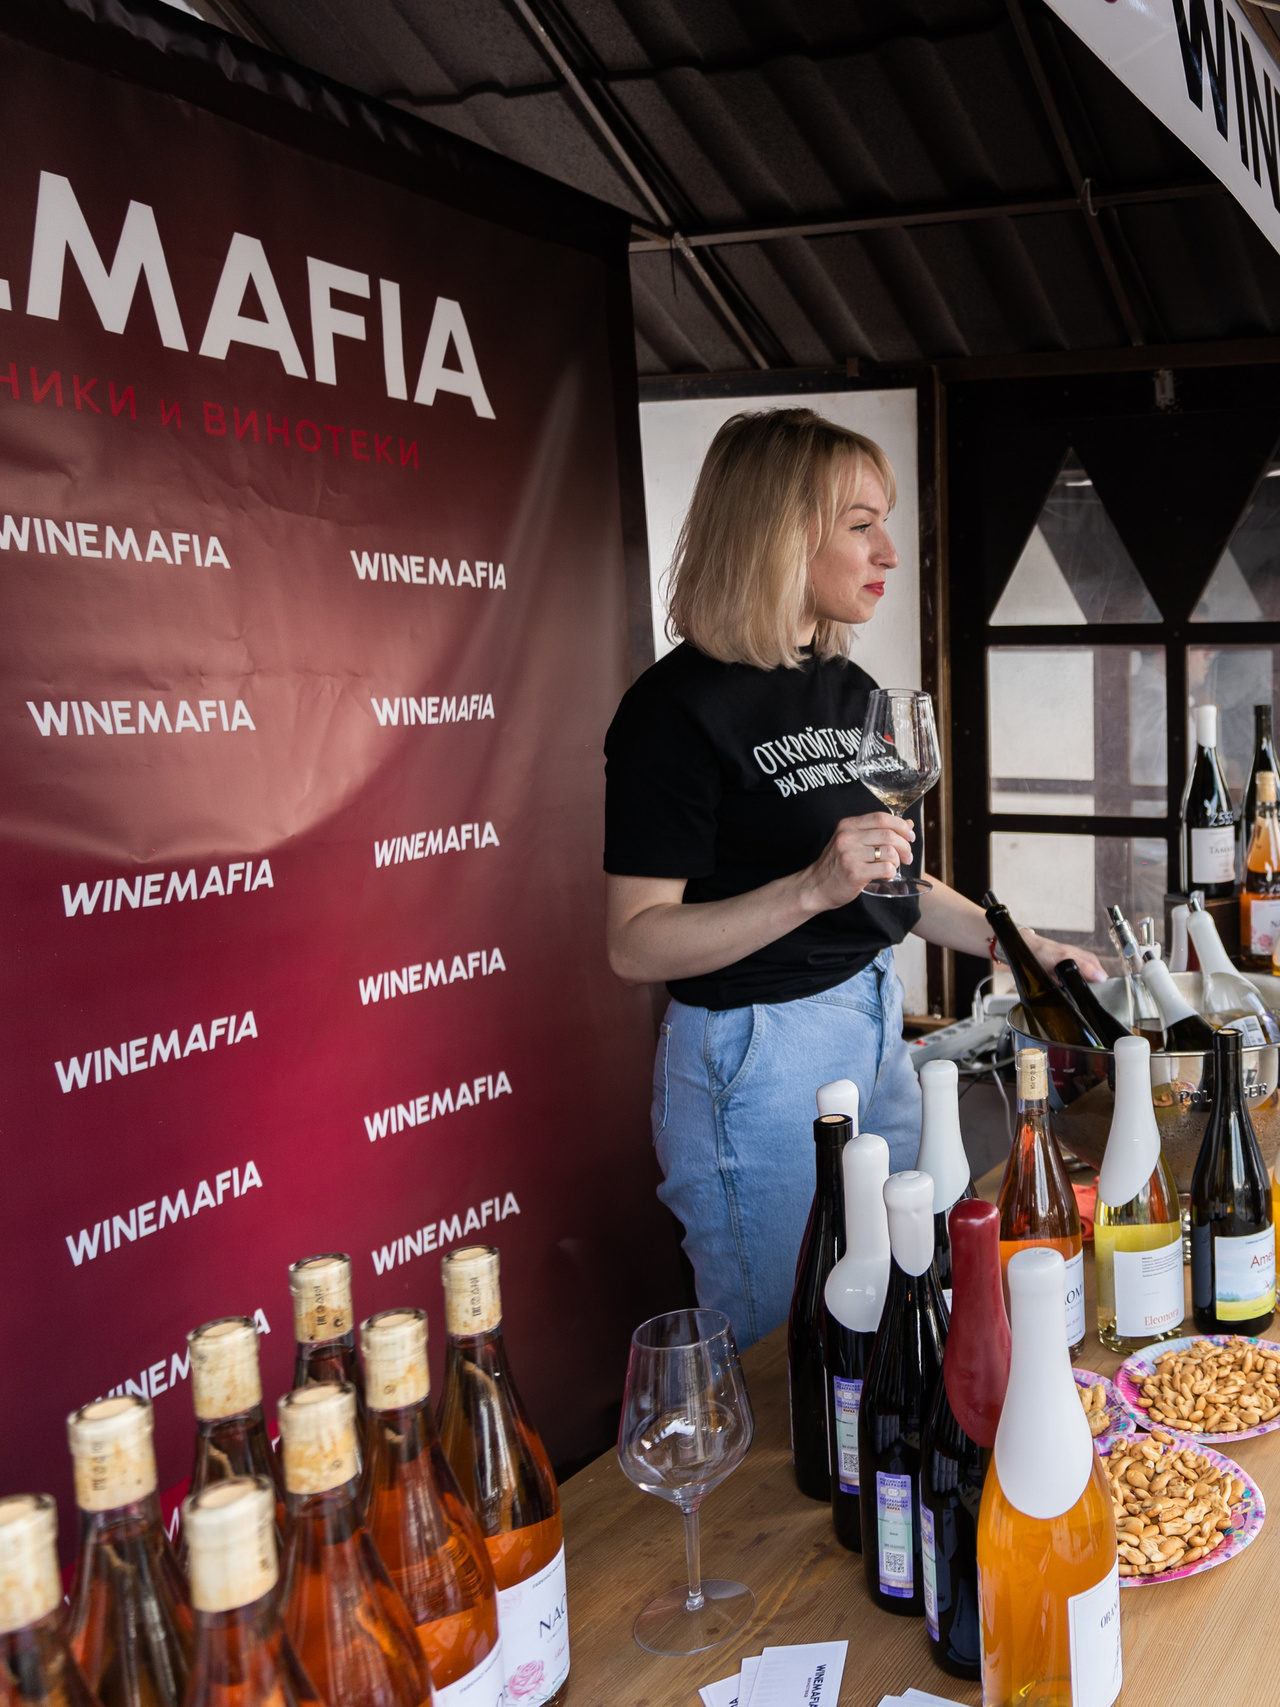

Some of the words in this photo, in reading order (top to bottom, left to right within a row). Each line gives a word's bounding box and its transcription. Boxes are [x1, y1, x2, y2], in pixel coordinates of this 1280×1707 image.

[0, 170, 496, 420] MAFIA
[204, 402, 420, 470] ВИНОТЕКИ
[0, 514, 231, 569] WINEMAFIA
[350, 551, 507, 590] WINEMAFIA
[26, 700, 257, 737] WINEMAFIA
[371, 693, 496, 727] WINEMAFIA
[753, 726, 845, 775] ОТКРОЙТЕ
[774, 763, 852, 798] ВКЛЮЧИТЕ
[374, 822, 500, 868] WINEMAFIA
[62, 859, 275, 917] WINEMAFIA
[359, 947, 506, 1005] WINEMAFIA
[55, 1010, 258, 1093] WINEMAFIA
[364, 1071, 512, 1142] WINEMAFIA
[65, 1160, 263, 1267] WINEMAFIA
[371, 1192, 521, 1276] WINEMAFIA
[1144, 1308, 1180, 1327] Eleonora
